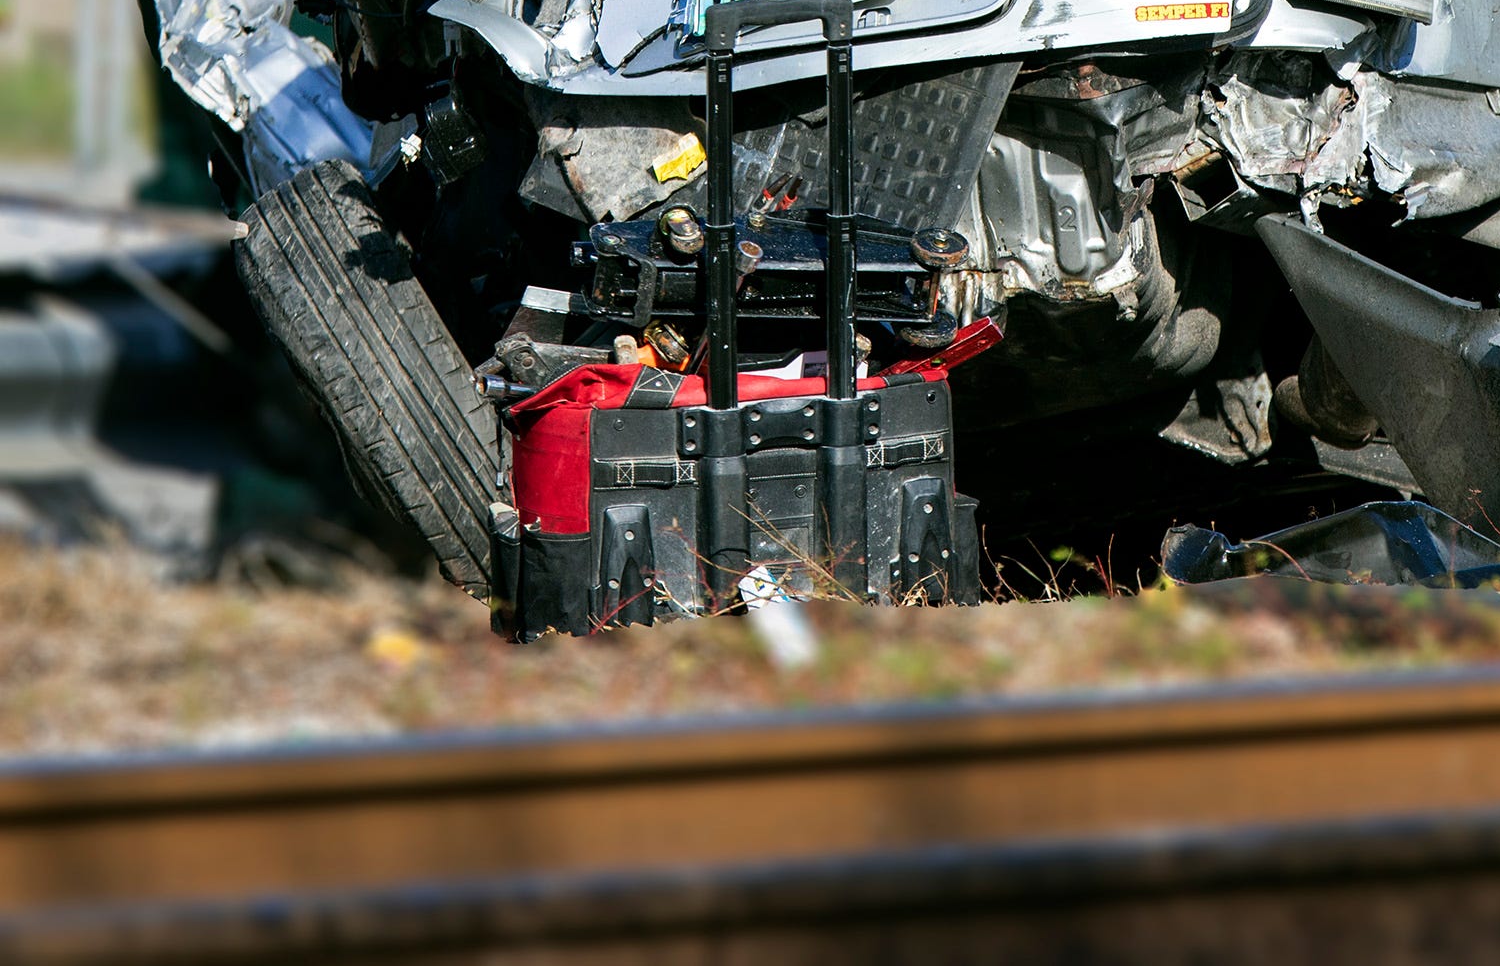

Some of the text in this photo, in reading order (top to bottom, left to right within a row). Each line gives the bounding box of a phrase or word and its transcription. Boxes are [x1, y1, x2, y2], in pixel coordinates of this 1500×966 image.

[1136, 3, 1229, 22] SEMPER FI
[1058, 205, 1077, 231] 2
